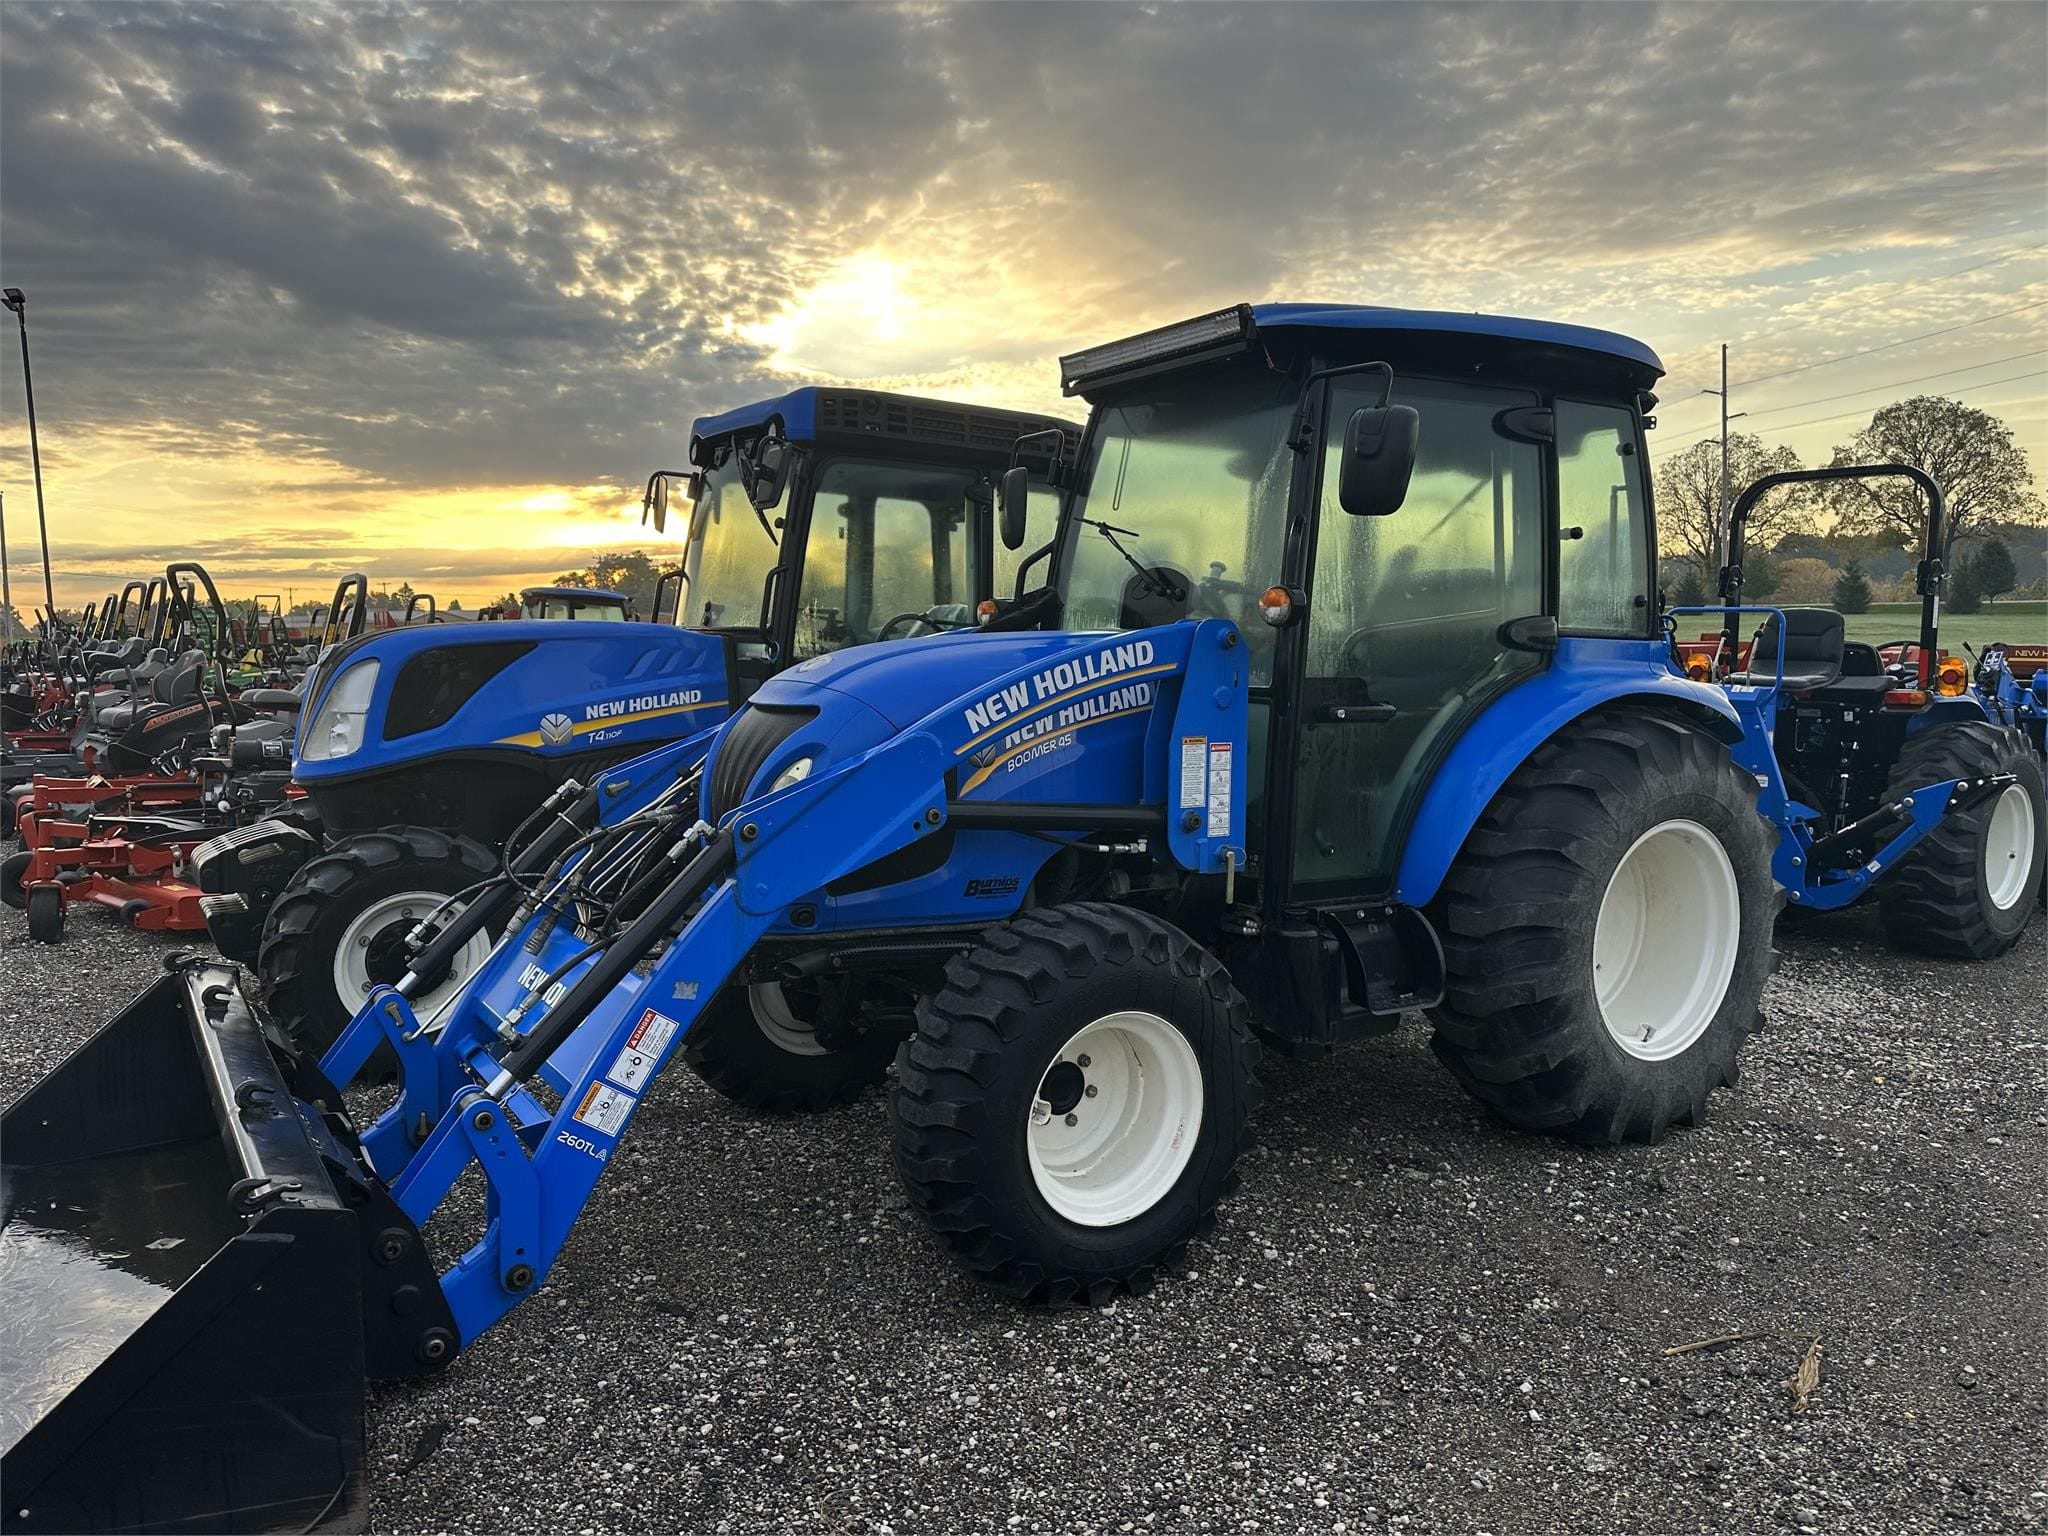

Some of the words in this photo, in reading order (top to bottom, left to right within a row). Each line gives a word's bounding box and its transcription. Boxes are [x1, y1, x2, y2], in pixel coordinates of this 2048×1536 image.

[964, 680, 1030, 734] NEW
[1033, 640, 1154, 700] HOLLAND
[586, 701, 625, 720] NEW
[629, 690, 702, 712] HOLLAND
[1005, 714, 1053, 749] NEW
[1007, 741, 1057, 773] BOOMER
[1058, 733, 1072, 748] 45
[517, 962, 550, 991] NEW
[635, 1012, 655, 1040] DANGER
[557, 1130, 607, 1162] 260TLA
